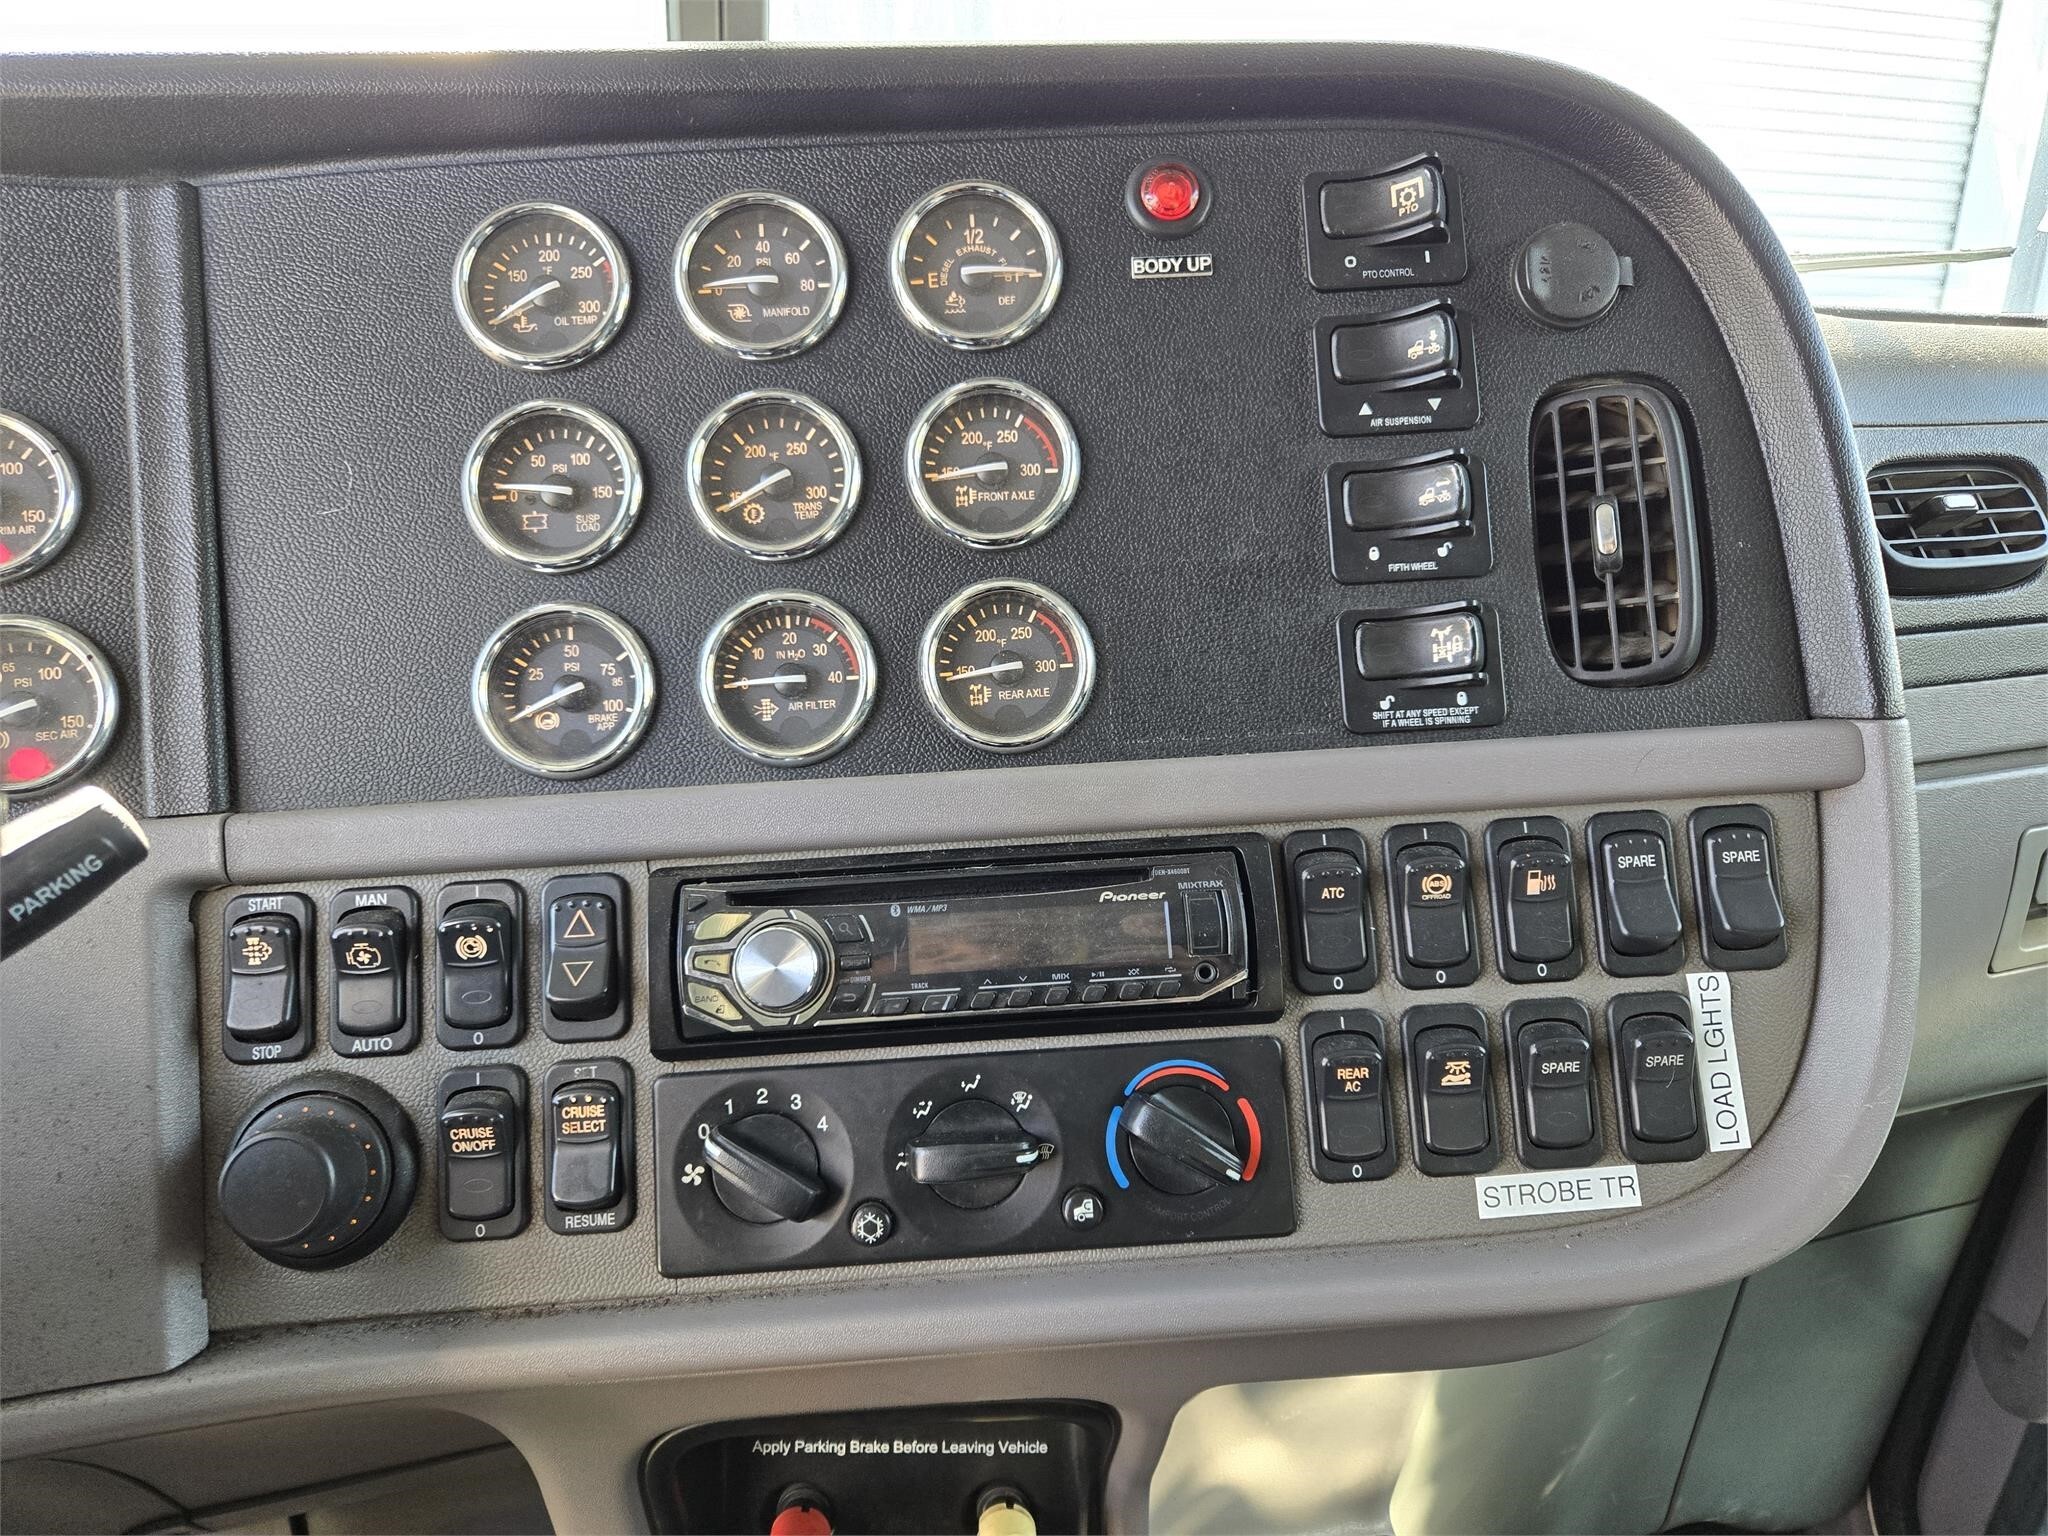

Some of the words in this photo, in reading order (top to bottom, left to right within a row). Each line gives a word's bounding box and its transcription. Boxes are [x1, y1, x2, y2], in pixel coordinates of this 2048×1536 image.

[1399, 204, 1418, 216] PTO
[964, 229, 984, 244] 1/2
[755, 241, 770, 253] 40
[955, 245, 998, 257] EXHAUST
[538, 250, 560, 262] 200
[727, 255, 741, 267] 20
[785, 252, 800, 265] 60
[756, 258, 771, 267] PSI
[1133, 257, 1183, 273] BODY
[1187, 257, 1211, 271] UP
[508, 270, 527, 282] 150
[570, 266, 592, 279] 250
[940, 258, 955, 286] DIESEL
[1362, 269, 1378, 279] PTO
[1380, 268, 1414, 278] CONTROL
[800, 279, 815, 291] 80
[928, 273, 939, 288] E
[579, 300, 600, 313] 300
[999, 296, 1016, 305] DEF
[763, 307, 810, 318] MANIFOLD
[554, 317, 569, 326] OIL
[571, 315, 598, 325] TEMP
[1370, 418, 1383, 427] AIR
[1385, 416, 1432, 426] SUSPENSION
[962, 432, 982, 444] 200
[997, 430, 1018, 443] 250
[744, 445, 766, 458] 200
[786, 442, 807, 456] 250
[531, 455, 546, 467] 50
[570, 453, 590, 466] 100
[0, 462, 24, 474] 100
[552, 464, 568, 472] PSI
[1020, 464, 1041, 476] 300
[510, 490, 518, 502] 0
[592, 486, 612, 498] 150
[806, 486, 827, 499] 300
[978, 491, 1009, 502] FRONT
[1011, 490, 1035, 500] AXLE
[793, 502, 822, 512] TRANS
[22, 510, 45, 522] 150
[576, 515, 600, 524] SUSP
[795, 511, 819, 520] TEMP
[18, 525, 36, 534] AIR
[576, 524, 600, 532] LOAD
[1388, 563, 1410, 572] FIFTH
[1411, 562, 1438, 571] WHEEL
[782, 632, 797, 644] 20
[975, 630, 996, 642] 200
[1010, 627, 1032, 640] 250
[564, 645, 580, 657] 50
[752, 648, 764, 660] 10
[776, 651, 786, 659] IN
[812, 644, 828, 656] 30
[2, 663, 16, 672] 65
[564, 663, 580, 672] PSI
[600, 664, 616, 676] 75
[1035, 660, 1056, 672] 300
[38, 667, 62, 680] 100
[528, 668, 544, 680] 25
[828, 671, 842, 683] 40
[14, 678, 32, 688] PSI
[612, 678, 623, 686] 85
[998, 690, 1024, 700] REAR
[1026, 688, 1050, 698] AXLE
[602, 700, 624, 712] 100
[788, 703, 803, 712] AIR
[806, 700, 836, 710] FILTER
[588, 714, 618, 724] BRAKE
[1373, 711, 1394, 720] SHIFT
[1395, 710, 1405, 718] AT
[1406, 710, 1422, 718] ANY
[1422, 708, 1448, 717] SPEED
[1449, 706, 1479, 716] EXCEPT
[60, 715, 84, 728] 150
[597, 722, 615, 731] APP
[1382, 720, 1390, 728] IF
[1398, 718, 1424, 727] WHEEL
[1425, 718, 1433, 726] IS
[1434, 716, 1471, 725] SPINNING
[35, 731, 58, 742] SEC
[60, 730, 78, 738] AIR
[1618, 854, 1656, 868] SPARE
[1722, 850, 1760, 864] SPARE
[8, 854, 103, 922] PARKING
[1178, 880, 1224, 890] MIXTRAX
[1430, 880, 1445, 888] ABS
[1100, 891, 1166, 902] Pioneer
[1322, 887, 1344, 899] ATC
[248, 896, 283, 912] START
[355, 894, 387, 907] MAN
[1052, 972, 1070, 980] MIX
[352, 1038, 392, 1052] AUTO
[252, 1045, 282, 1060] STOP
[1542, 1060, 1580, 1074] SPARE
[1646, 1054, 1684, 1068] SPARE
[1337, 1067, 1369, 1080] REAR
[1344, 1081, 1362, 1092] AC
[756, 1088, 768, 1105] 2
[790, 1094, 802, 1110] 3
[562, 1105, 605, 1119] CRUISE
[724, 1098, 733, 1114] 1
[1711, 1071, 1740, 1145] LOAD
[562, 1120, 606, 1134] SELECT
[816, 1116, 829, 1132] 4
[450, 1126, 494, 1140] CRUISE
[452, 1139, 496, 1152] ON/OFF
[1484, 1179, 1592, 1208] STROBE
[1600, 1175, 1636, 1198] TR
[565, 1213, 616, 1228] RESUME
[752, 1440, 791, 1456] Apply
[794, 1440, 846, 1456] Parking
[850, 1440, 890, 1454] Brake
[893, 1440, 938, 1454] Before
[942, 1440, 994, 1456] Leaving
[998, 1440, 1048, 1454] Vehicle
